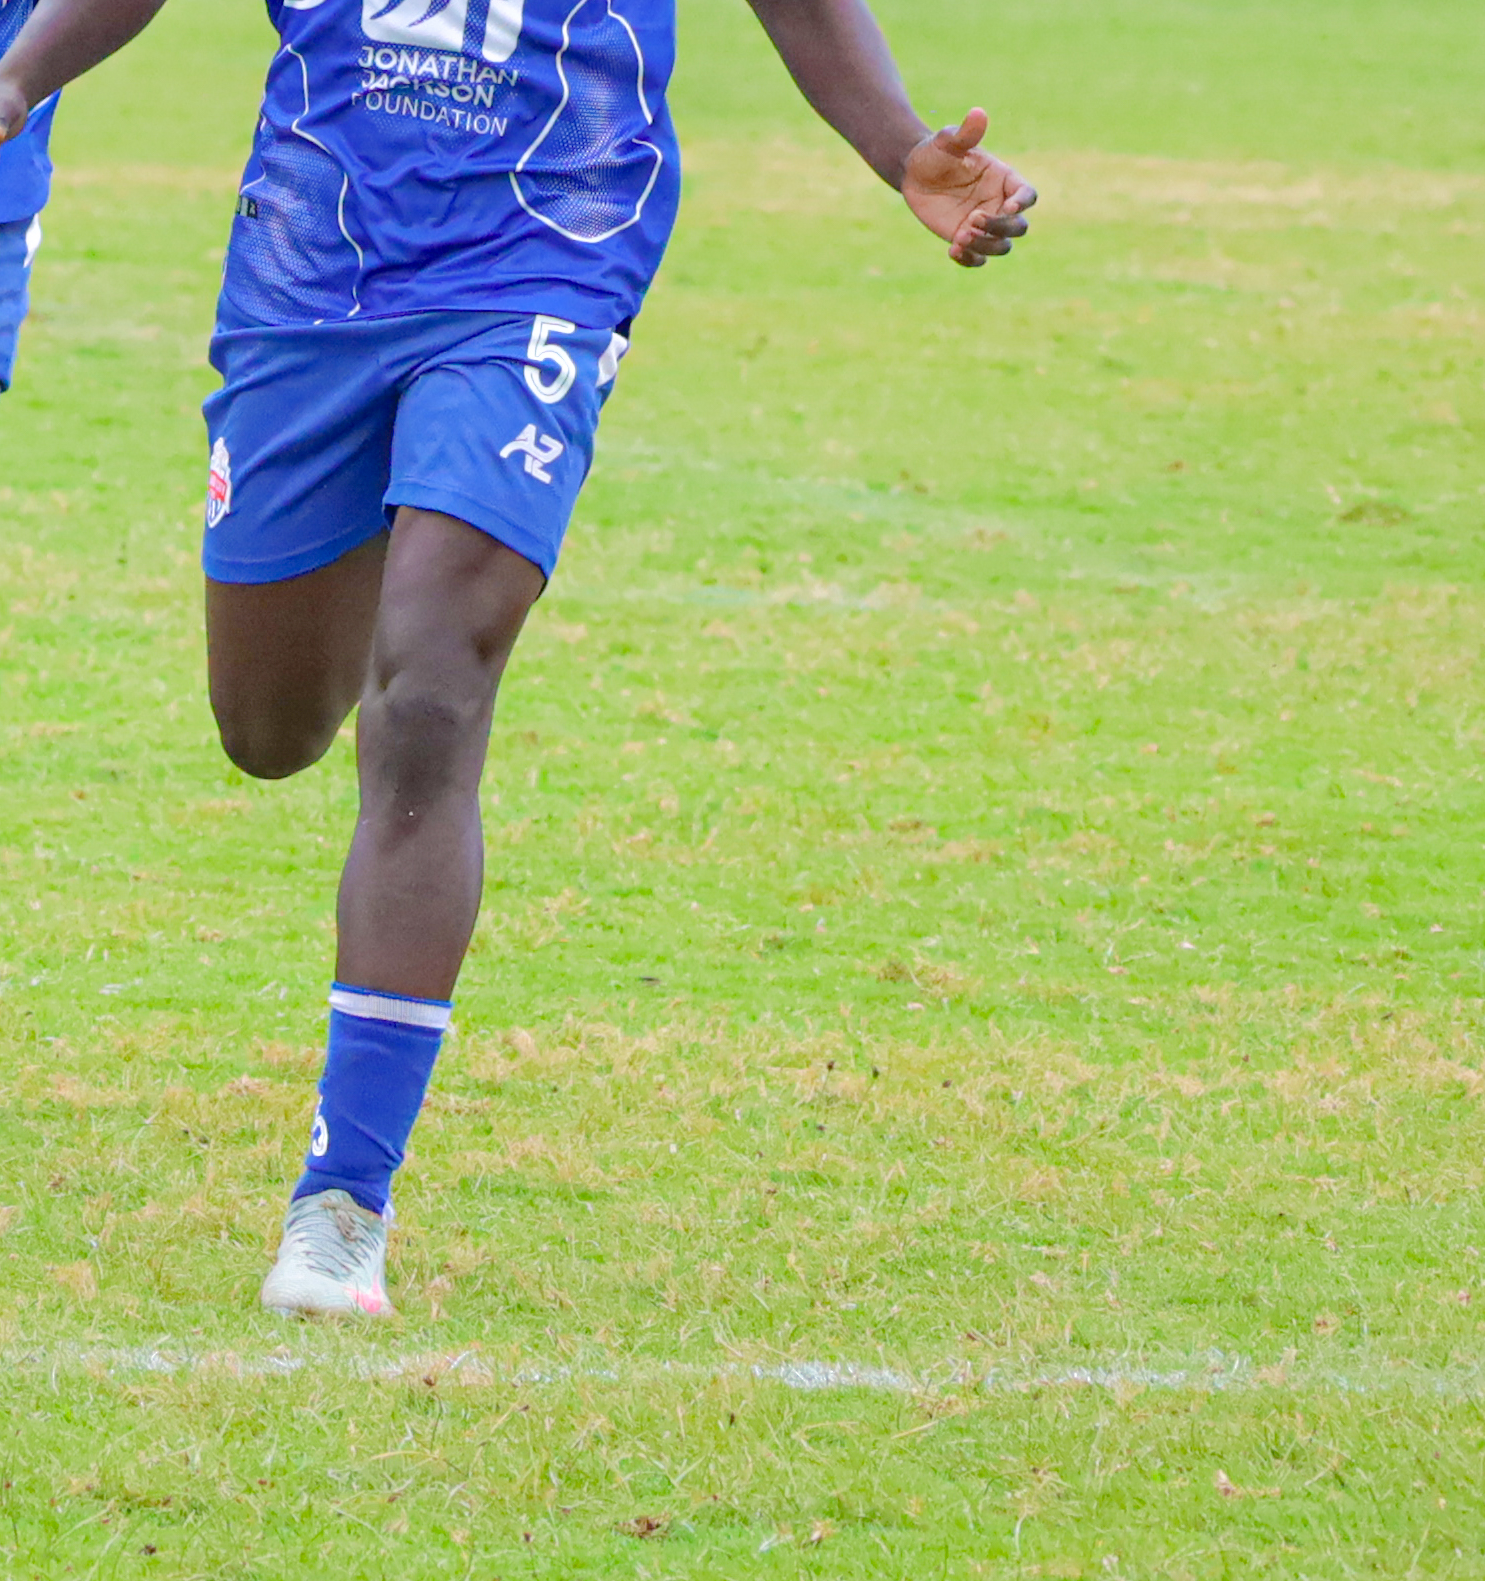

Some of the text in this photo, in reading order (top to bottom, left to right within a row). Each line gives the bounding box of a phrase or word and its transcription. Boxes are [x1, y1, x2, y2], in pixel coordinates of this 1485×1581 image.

[358, 45, 519, 87] JONATHAN
[351, 91, 508, 137] FOUNDATION
[524, 314, 577, 404] 5
